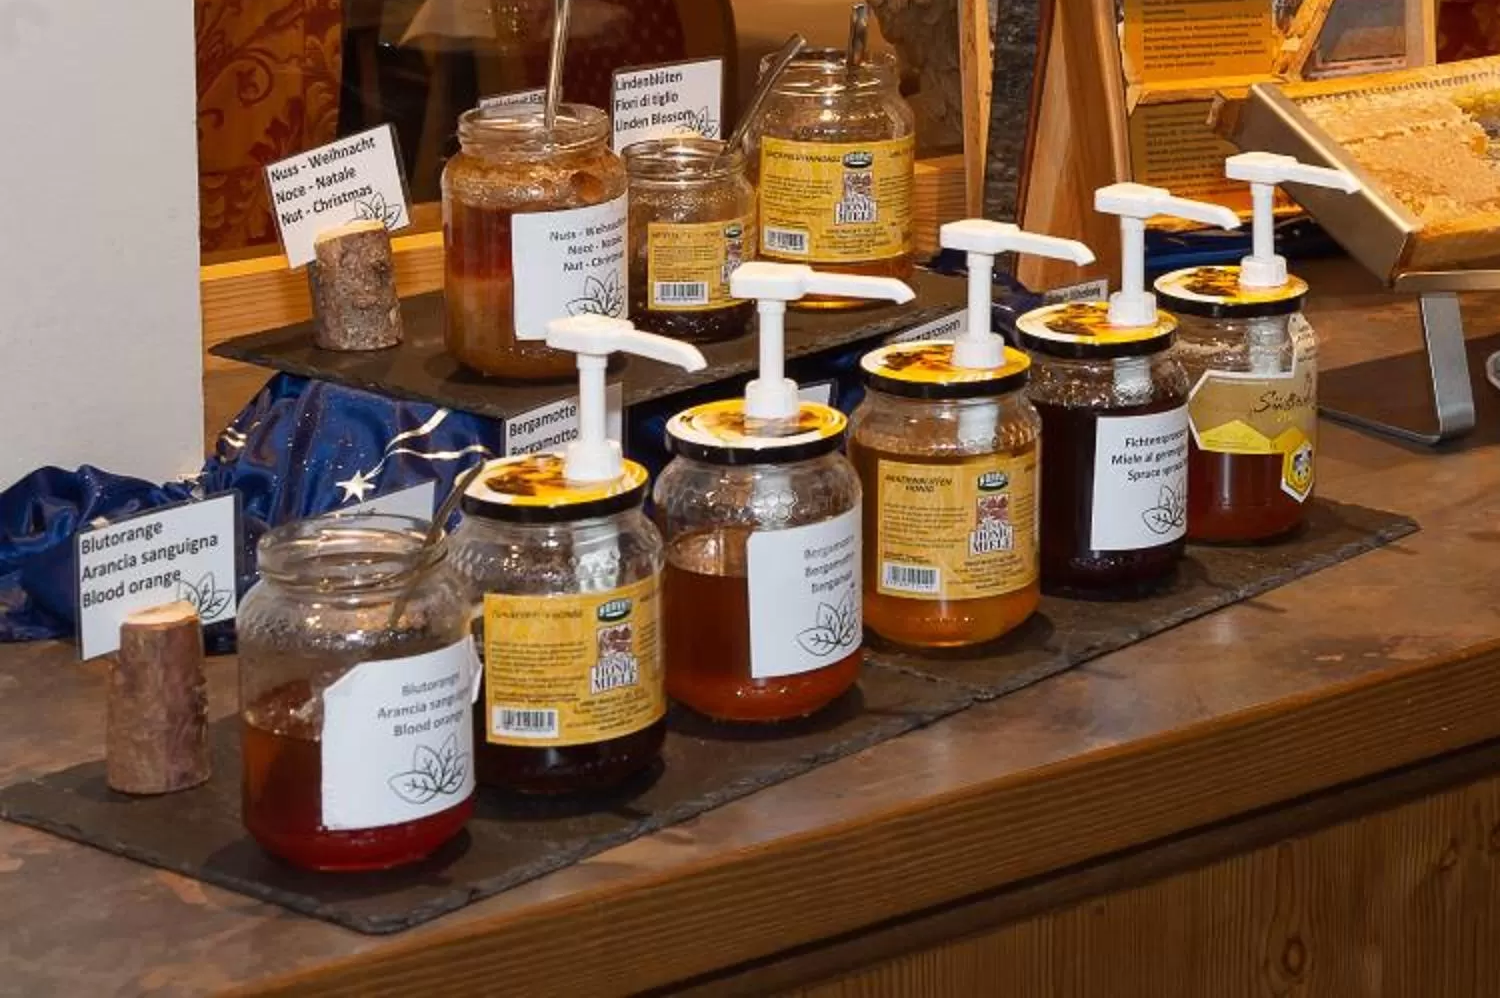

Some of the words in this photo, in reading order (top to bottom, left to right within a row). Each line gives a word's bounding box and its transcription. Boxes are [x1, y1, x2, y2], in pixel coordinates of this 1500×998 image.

[615, 71, 683, 91] Lindenblüten
[615, 115, 649, 132] Linden
[651, 109, 695, 125] Blossom
[271, 166, 299, 183] Nuss
[308, 136, 376, 169] Weihnacht
[276, 186, 306, 205] Noce
[315, 166, 357, 191] Natale
[281, 209, 304, 227] Nut
[313, 184, 373, 213] Christmas
[509, 405, 577, 437] Bergamotte
[1111, 454, 1143, 465] Miele
[81, 521, 163, 555] Blutorange
[82, 554, 137, 582] Arancia
[141, 534, 218, 565] sanguigna
[83, 581, 125, 608] Blood
[129, 569, 182, 594] orange
[393, 718, 431, 736] Blood
